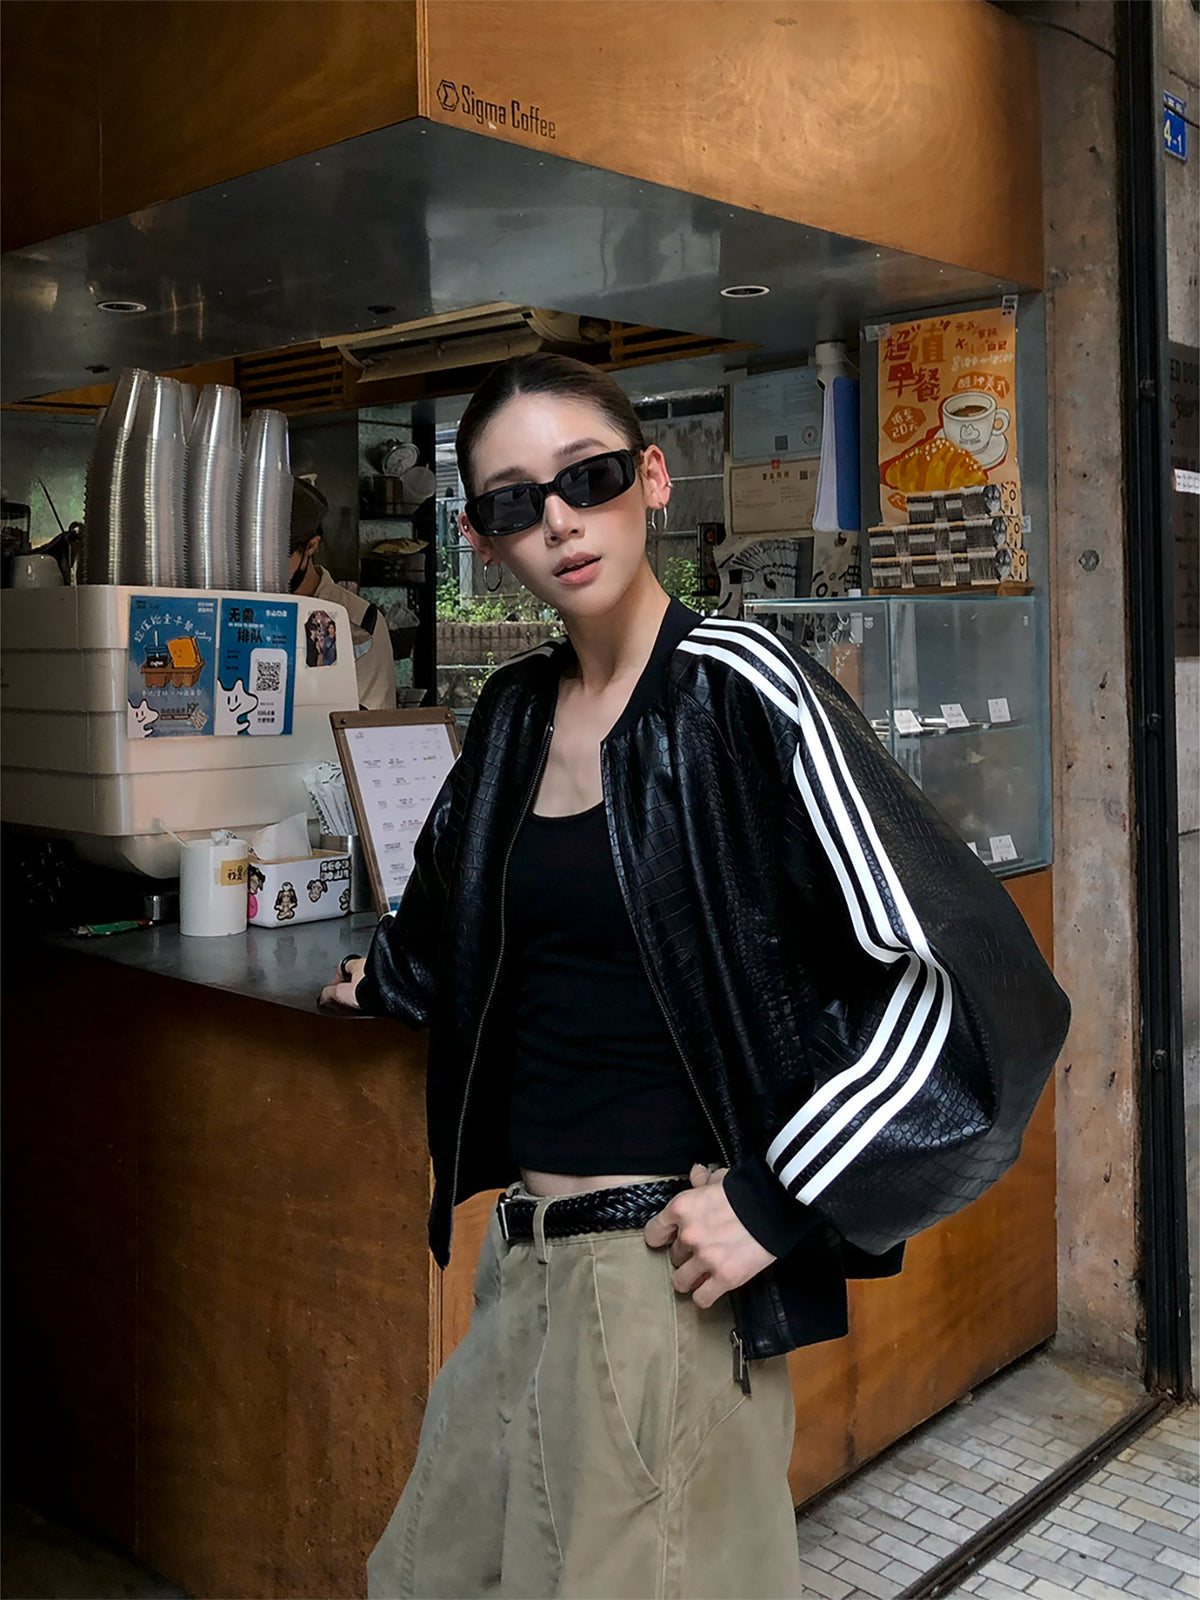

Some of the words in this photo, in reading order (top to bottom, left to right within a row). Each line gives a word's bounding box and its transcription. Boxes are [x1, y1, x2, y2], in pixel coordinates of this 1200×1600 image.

[461, 84, 507, 125] Sigma
[511, 100, 556, 139] Coffee
[883, 322, 945, 364] 超值
[887, 362, 941, 402] 早餐
[229, 607, 255, 623] 无需
[237, 628, 263, 643] 排队
